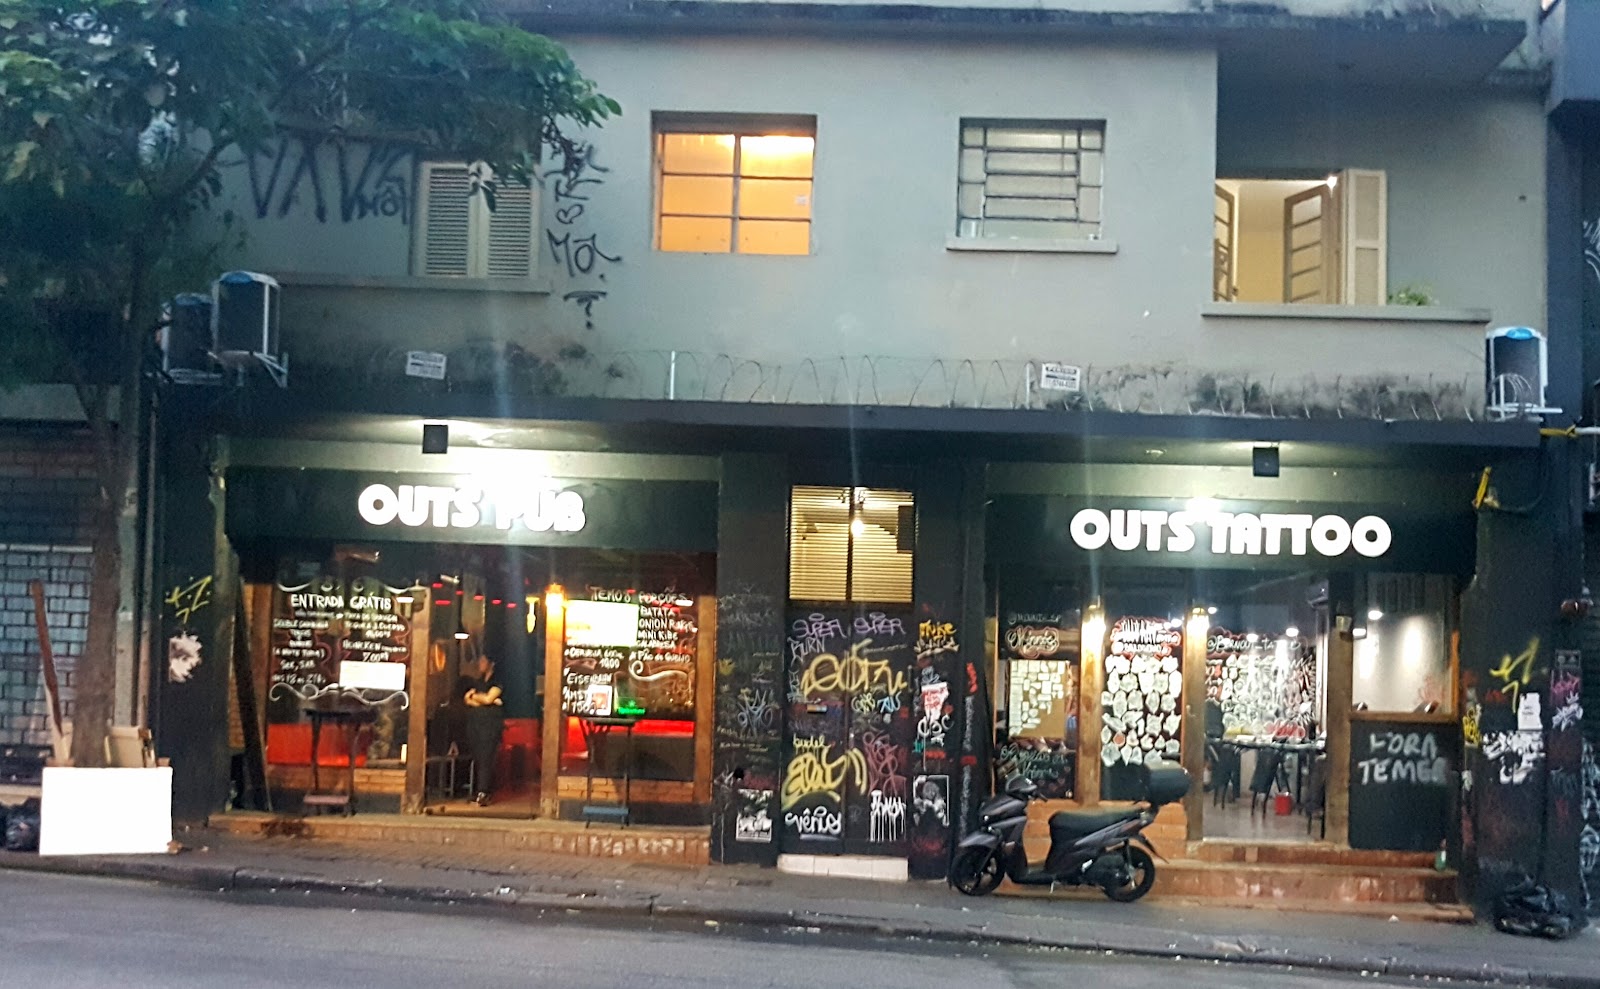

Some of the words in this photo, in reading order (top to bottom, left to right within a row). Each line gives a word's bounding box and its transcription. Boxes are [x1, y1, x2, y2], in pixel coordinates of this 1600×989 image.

[358, 483, 481, 528] OUTS
[495, 488, 586, 532] PUB
[1070, 508, 1195, 552] OUTS
[1206, 512, 1392, 557] TATTOO
[291, 593, 344, 609] ENTRADA
[350, 592, 392, 610] GRÁTIS
[640, 605, 677, 617] BATATA
[638, 618, 668, 630] ONION
[1357, 756, 1448, 786] TEMER
